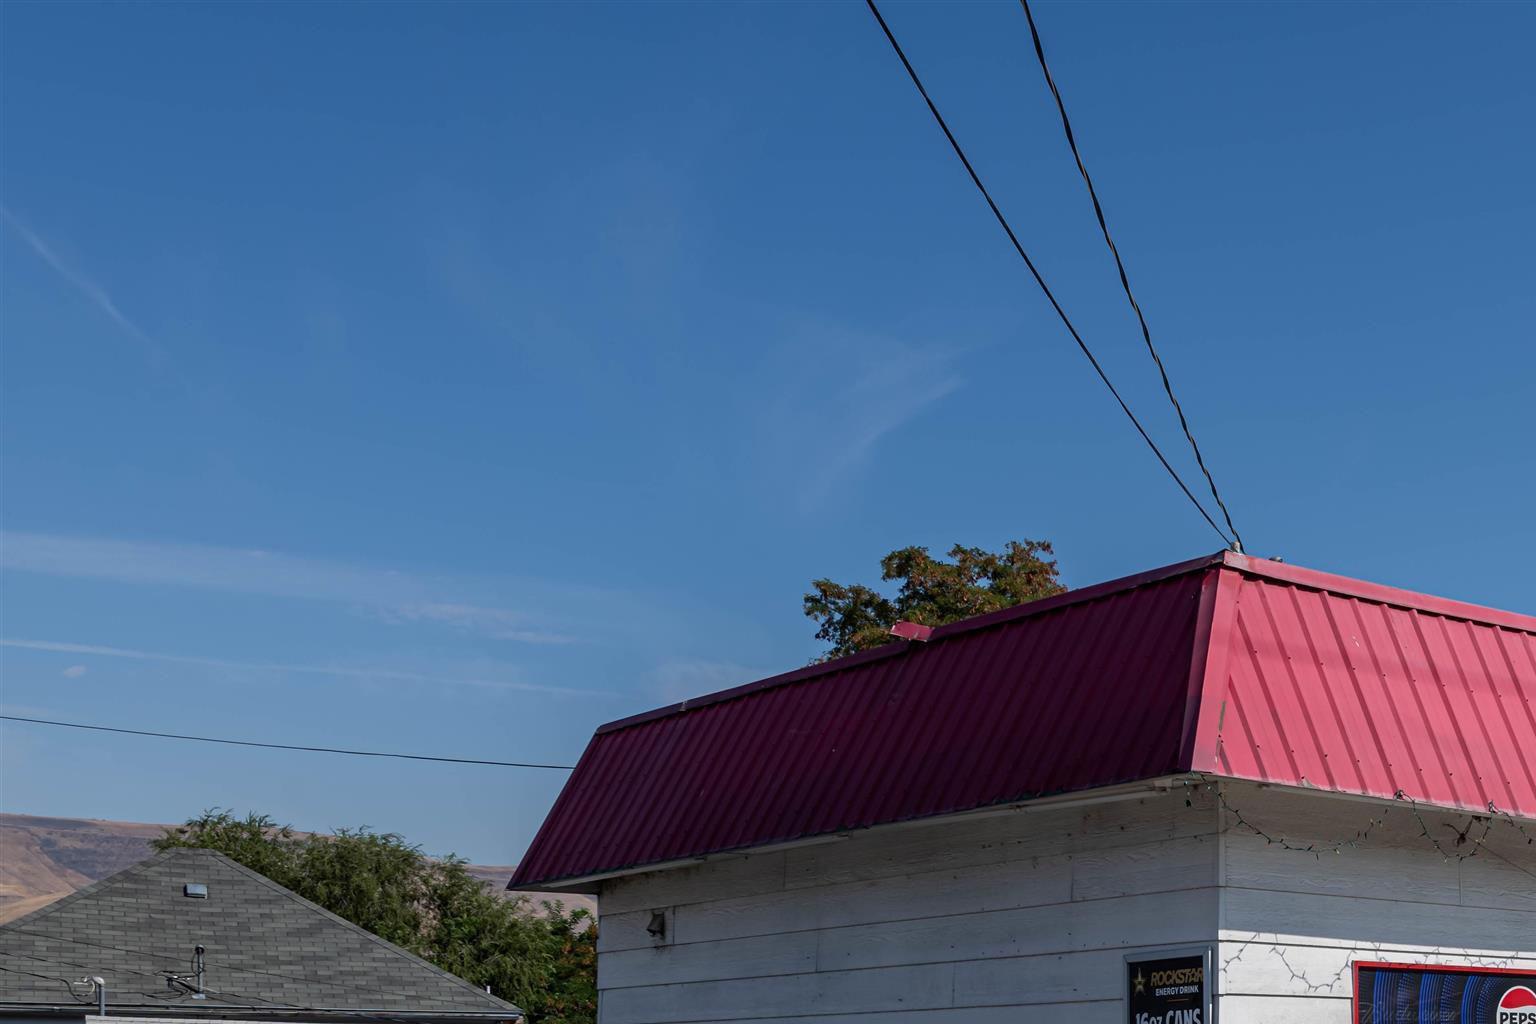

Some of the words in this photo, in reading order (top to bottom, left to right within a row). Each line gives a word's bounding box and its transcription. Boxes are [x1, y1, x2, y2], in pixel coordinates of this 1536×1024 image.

[1151, 967, 1203, 986] ROCKSTAR
[1155, 986, 1179, 996] ENERGY
[1180, 985, 1199, 995] DRINK
